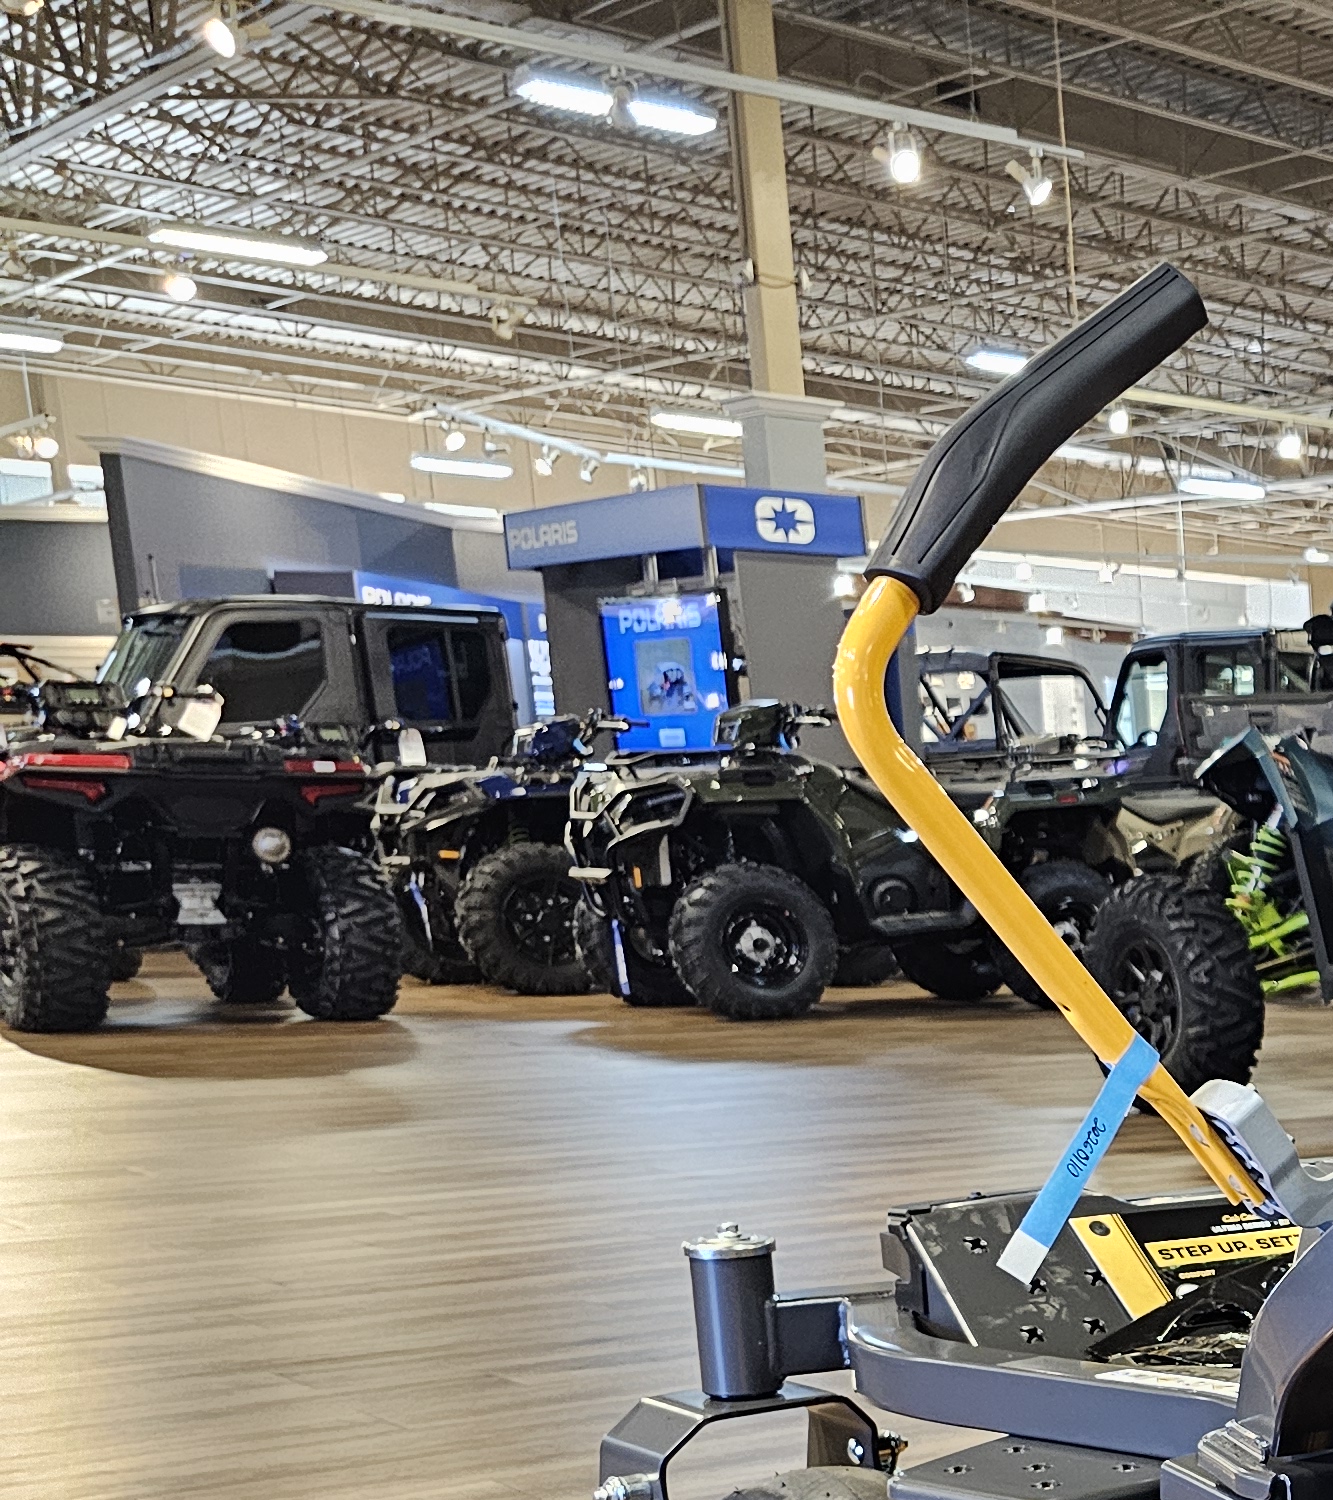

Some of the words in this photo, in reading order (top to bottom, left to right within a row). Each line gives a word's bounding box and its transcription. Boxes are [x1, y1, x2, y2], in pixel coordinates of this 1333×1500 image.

[509, 520, 578, 550] POLARIS
[1158, 1244, 1213, 1260] STEP
[1217, 1240, 1254, 1254] UP.
